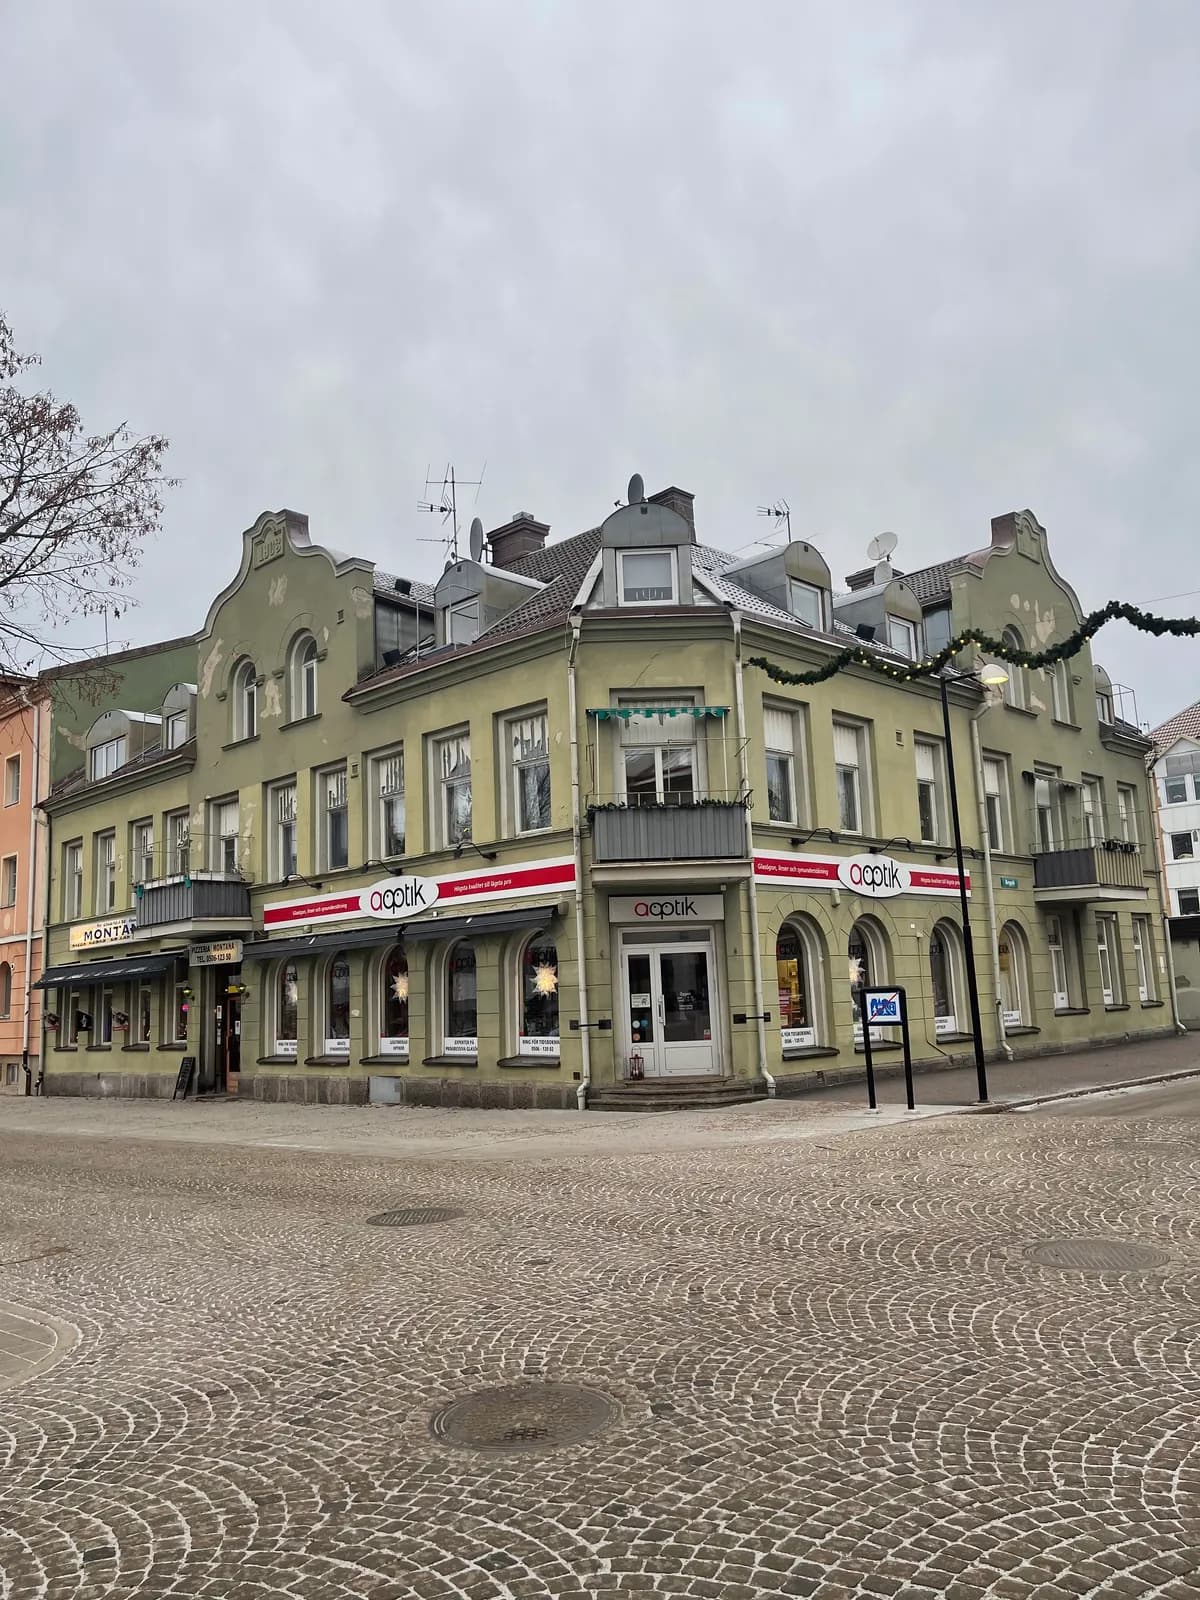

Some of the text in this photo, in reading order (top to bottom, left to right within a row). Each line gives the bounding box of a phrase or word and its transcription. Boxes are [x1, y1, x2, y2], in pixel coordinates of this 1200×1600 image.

[84, 924, 137, 941] MONTAN
[192, 942, 234, 954] PIZZERIA MONTANA
